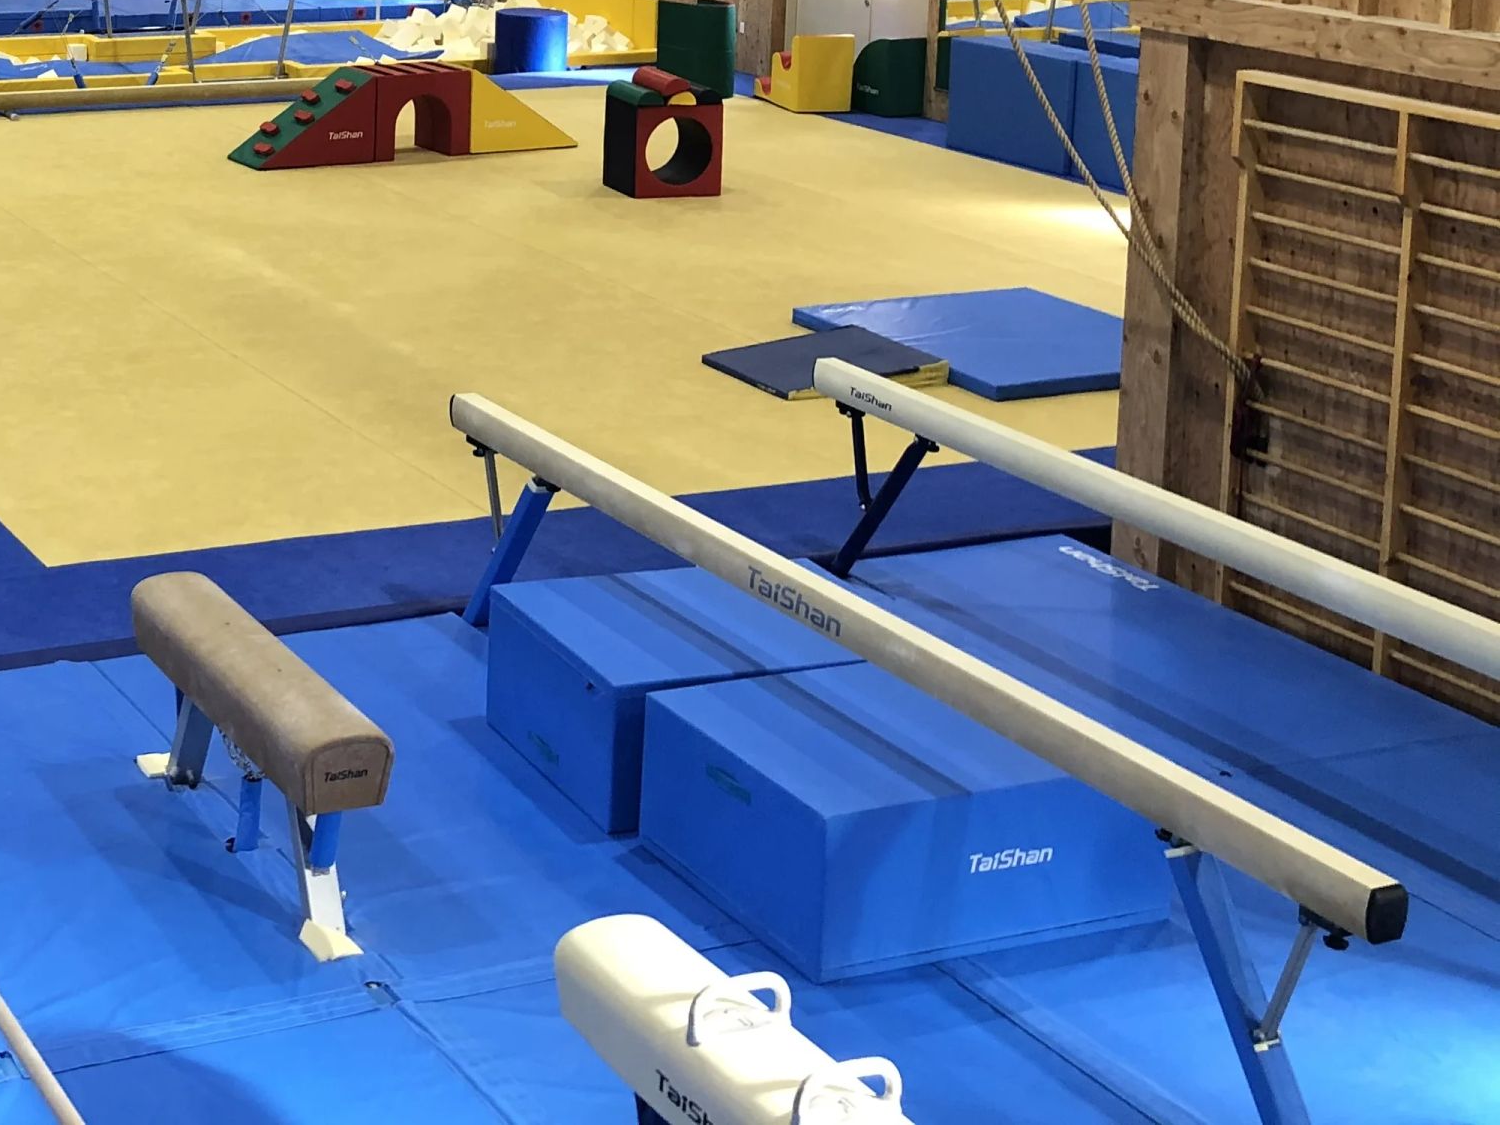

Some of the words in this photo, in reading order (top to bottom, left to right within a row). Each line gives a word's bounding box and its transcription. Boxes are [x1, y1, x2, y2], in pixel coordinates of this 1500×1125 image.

[328, 130, 364, 140] TaiShan
[850, 386, 893, 412] TaiShan
[748, 565, 842, 637] TaiShan
[324, 769, 368, 783] TaiShan
[969, 847, 1053, 874] TaiShan
